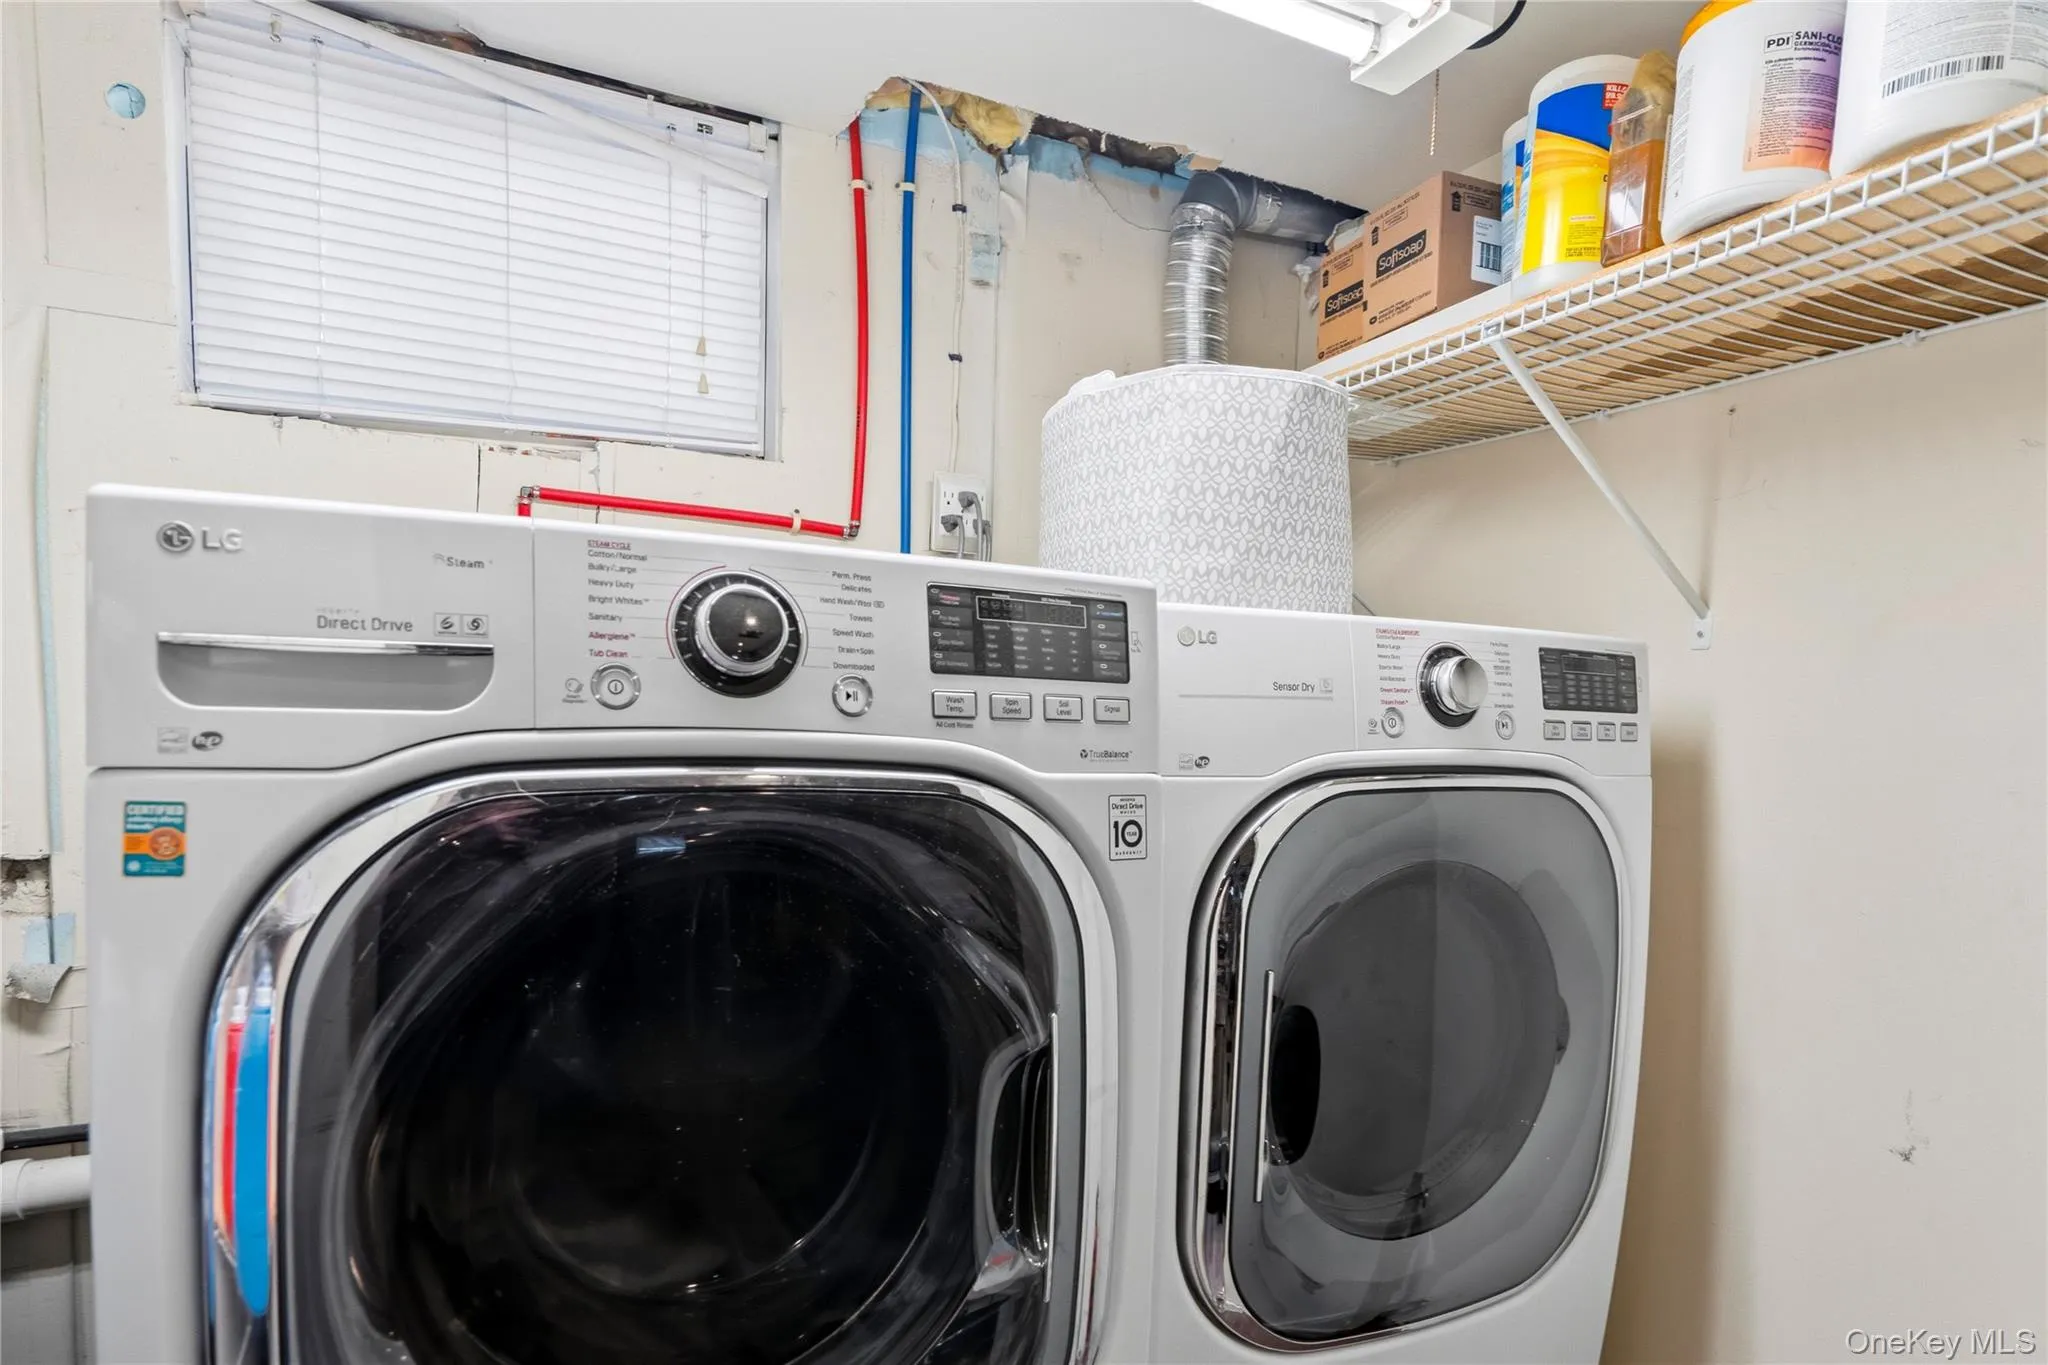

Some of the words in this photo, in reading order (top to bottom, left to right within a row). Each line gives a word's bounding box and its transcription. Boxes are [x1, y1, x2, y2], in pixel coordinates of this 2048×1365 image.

[1766, 36, 1790, 48] PDI
[1378, 238, 1425, 271] Softsoap
[201, 527, 244, 552] LG
[588, 540, 610, 549] STEAM
[611, 541, 631, 551] CYCLE
[588, 549, 647, 561] Cotton/Normal
[446, 556, 485, 569] Steam
[588, 563, 637, 574] Bulky/Large
[588, 579, 613, 588] Heavy
[615, 580, 634, 589] Duty
[841, 583, 872, 593] Delicates
[588, 594, 613, 604] Bright
[588, 612, 622, 622] Sanitary
[849, 613, 873, 622] Towels
[316, 615, 366, 631] Direct
[371, 617, 413, 632] Drive
[832, 628, 854, 637] Speed
[855, 630, 874, 638] Wash
[1198, 630, 1217, 644] LG
[589, 648, 604, 657] Tub
[605, 649, 629, 658] Clean
[833, 662, 875, 671] Downloaded
[1272, 681, 1300, 692] Sensor
[1301, 682, 1316, 693] Dry
[946, 696, 965, 704] Wash
[1004, 698, 1019, 707] Spin
[1058, 700, 1069, 708] Soil
[1002, 706, 1022, 715] Speed
[1056, 707, 1072, 716] Level
[1103, 705, 1121, 714] Signal
[1129, 802, 1143, 810] Drive
[1113, 819, 1143, 848] 10
